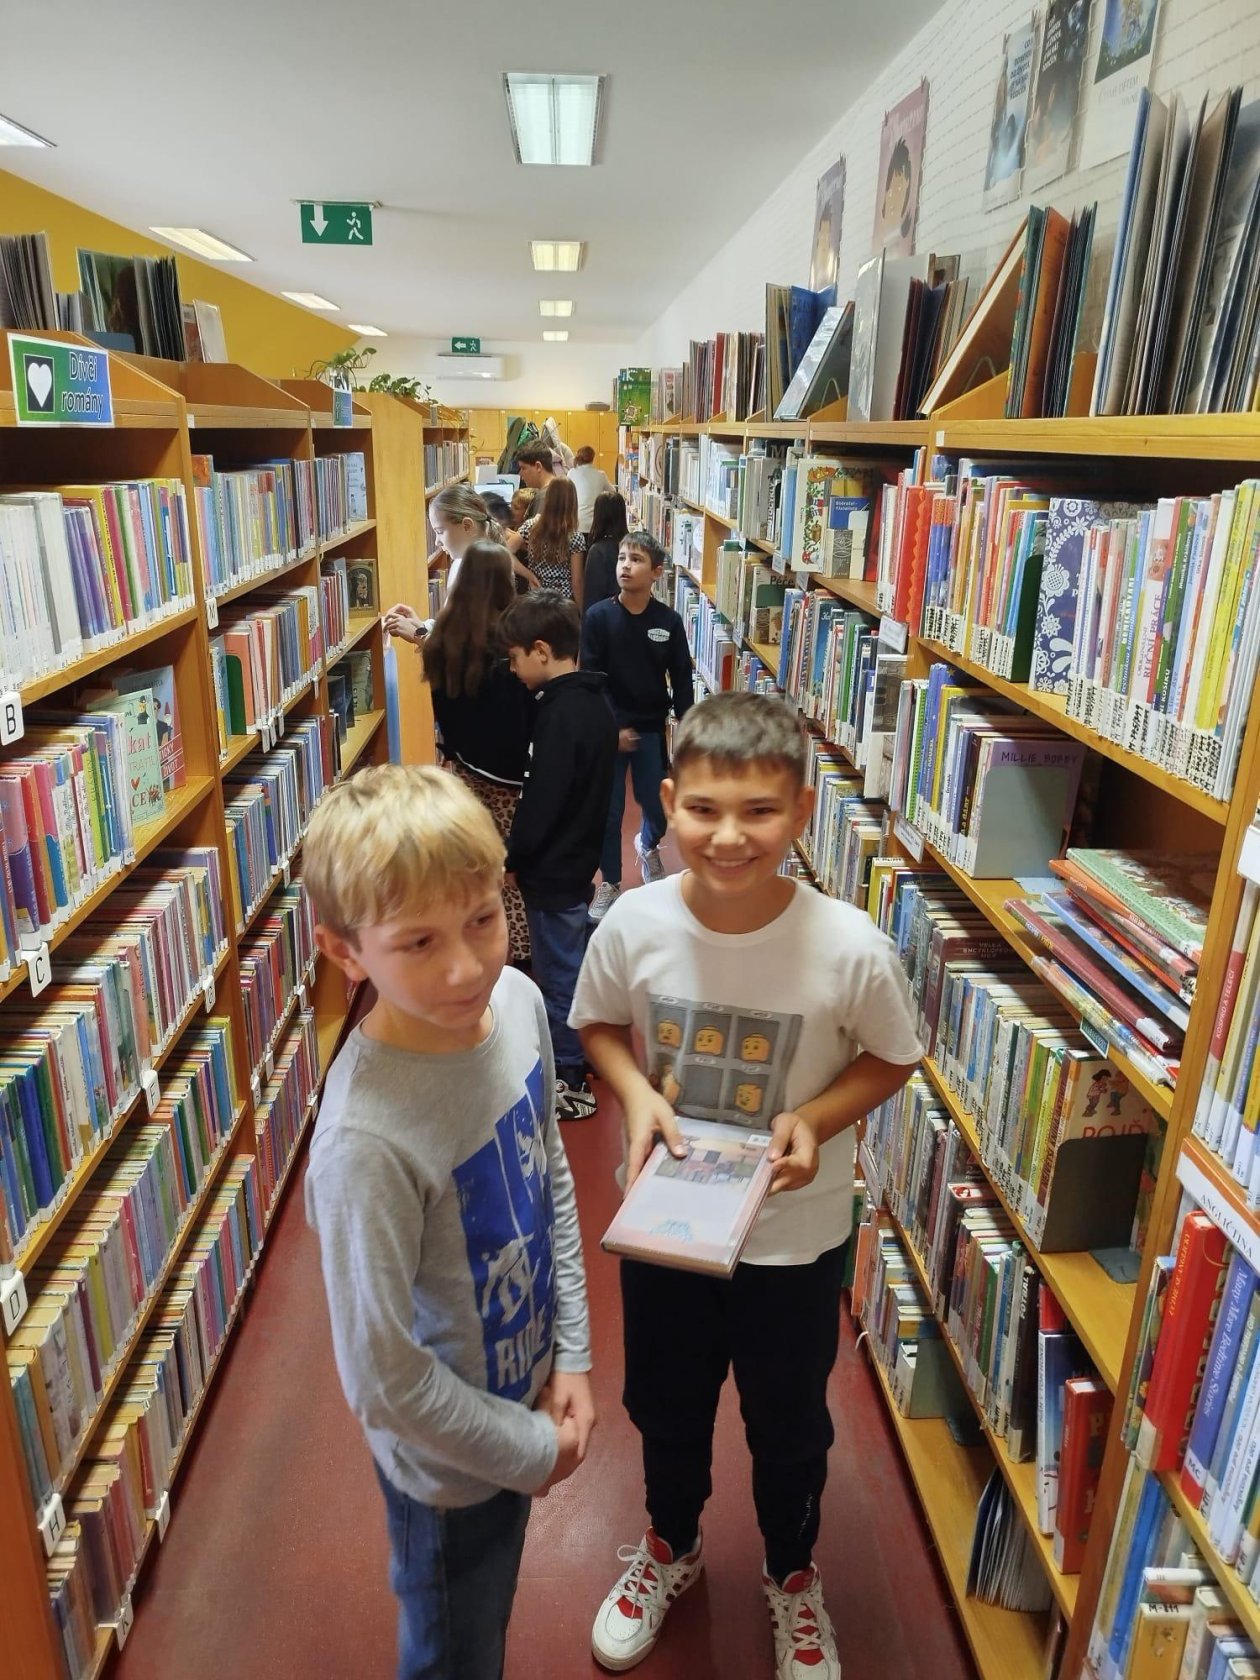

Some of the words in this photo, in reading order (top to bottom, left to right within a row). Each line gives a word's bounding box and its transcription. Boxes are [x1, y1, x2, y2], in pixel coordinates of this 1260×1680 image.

[69, 351, 97, 382] Dívčí
[62, 387, 103, 420] romány
[1150, 594, 1162, 633] PRÁCE
[5, 704, 15, 734] B
[1001, 751, 1037, 762] MILLIE
[35, 954, 45, 983] C
[1201, 1194, 1252, 1258] ANGLIČTINA
[1020, 1273, 1029, 1319] FOTBAL
[1229, 1267, 1248, 1303] Many
[10, 1292, 20, 1321] D
[1223, 1301, 1239, 1332] More
[1211, 1331, 1232, 1379] Bedtime
[1202, 1378, 1220, 1417] Stories
[1188, 1458, 1201, 1479] MC
[49, 1512, 59, 1536] H
